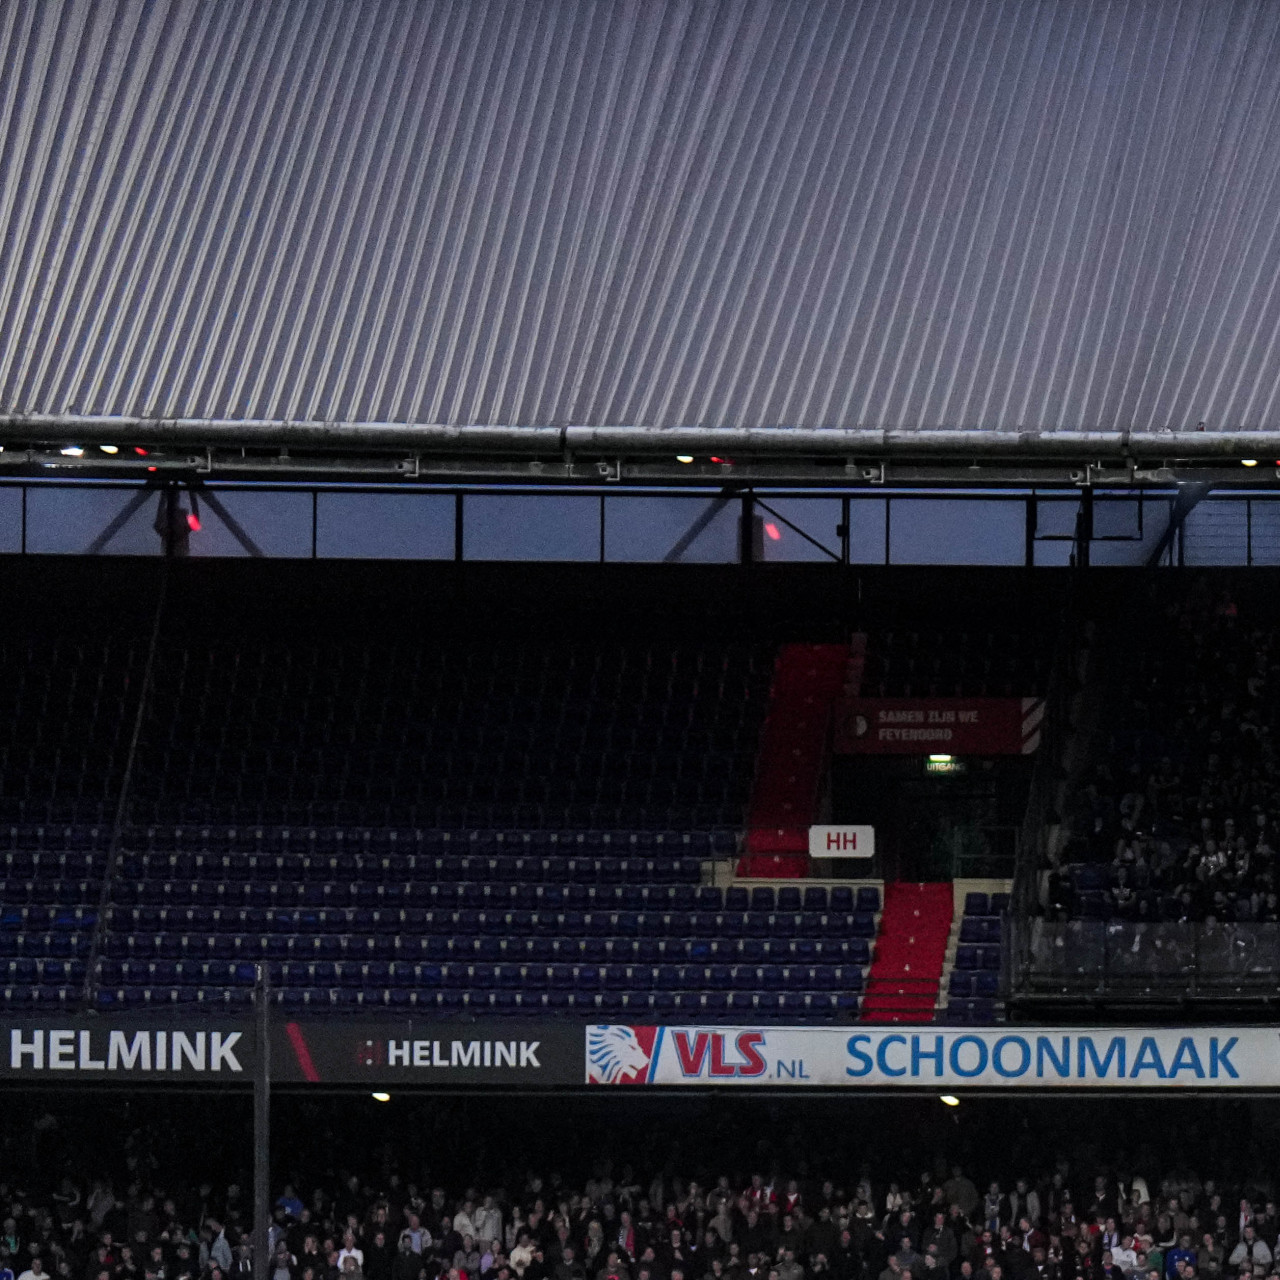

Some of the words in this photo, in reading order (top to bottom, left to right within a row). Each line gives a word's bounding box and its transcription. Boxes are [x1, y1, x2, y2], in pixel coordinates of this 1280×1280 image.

[826, 832, 857, 850] HH
[11, 1028, 243, 1072] HELMINK
[388, 1039, 541, 1069] HELMINK
[845, 1034, 1239, 1080] SCHOONMAAK
